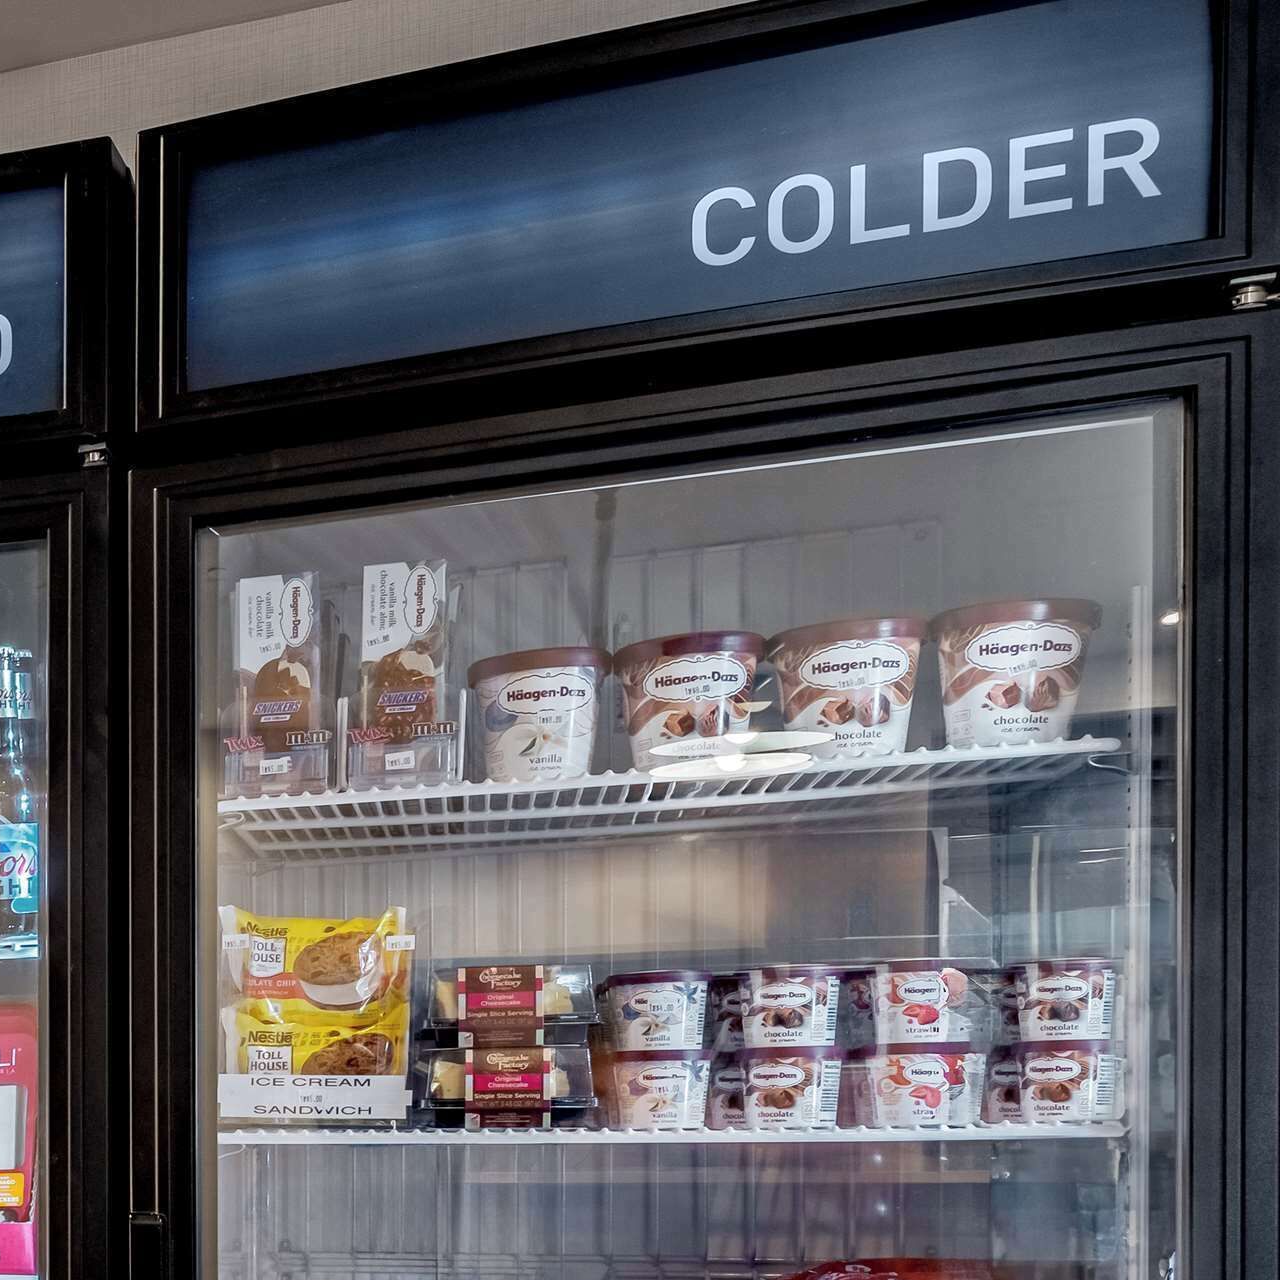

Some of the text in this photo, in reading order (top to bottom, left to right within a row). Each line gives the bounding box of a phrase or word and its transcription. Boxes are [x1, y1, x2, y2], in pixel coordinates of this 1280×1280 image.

[689, 116, 1161, 266] COLDER
[416, 574, 426, 627] Häagen-Dazs
[265, 591, 275, 639] vanilla milk
[292, 586, 301, 639] Häagen-Dazs
[389, 610, 397, 627] milk
[978, 641, 1073, 657] Häagen-Dazs
[811, 657, 901, 675] Häagen-Dazs
[378, 688, 429, 707] SNICKERS
[507, 687, 586, 701] Häagen-Dazs
[253, 700, 301, 715] SNICKERS
[993, 714, 1049, 725] chocolate
[348, 727, 392, 744] TWIX
[224, 735, 265, 752] TWIX
[528, 754, 563, 765] vanilla
[252, 940, 277, 952] TOLL
[275, 979, 297, 988] CHIP
[1039, 985, 1083, 994] Häagen-Dazs
[761, 991, 807, 1000] Häagen-Dazs
[1040, 1023, 1079, 1031] chocolate
[645, 1034, 671, 1042] vanilla
[255, 1049, 284, 1060] TOLL
[250, 1061, 288, 1071] HOUSE
[498, 1060, 529, 1071] Factory
[753, 1072, 797, 1080] Häagen-Dazs
[251, 1078, 371, 1087] ICE CREAM
[253, 1105, 372, 1115] SANDWICH
[1034, 1104, 1071, 1112] chocolate
[758, 1110, 794, 1118] chocolate
